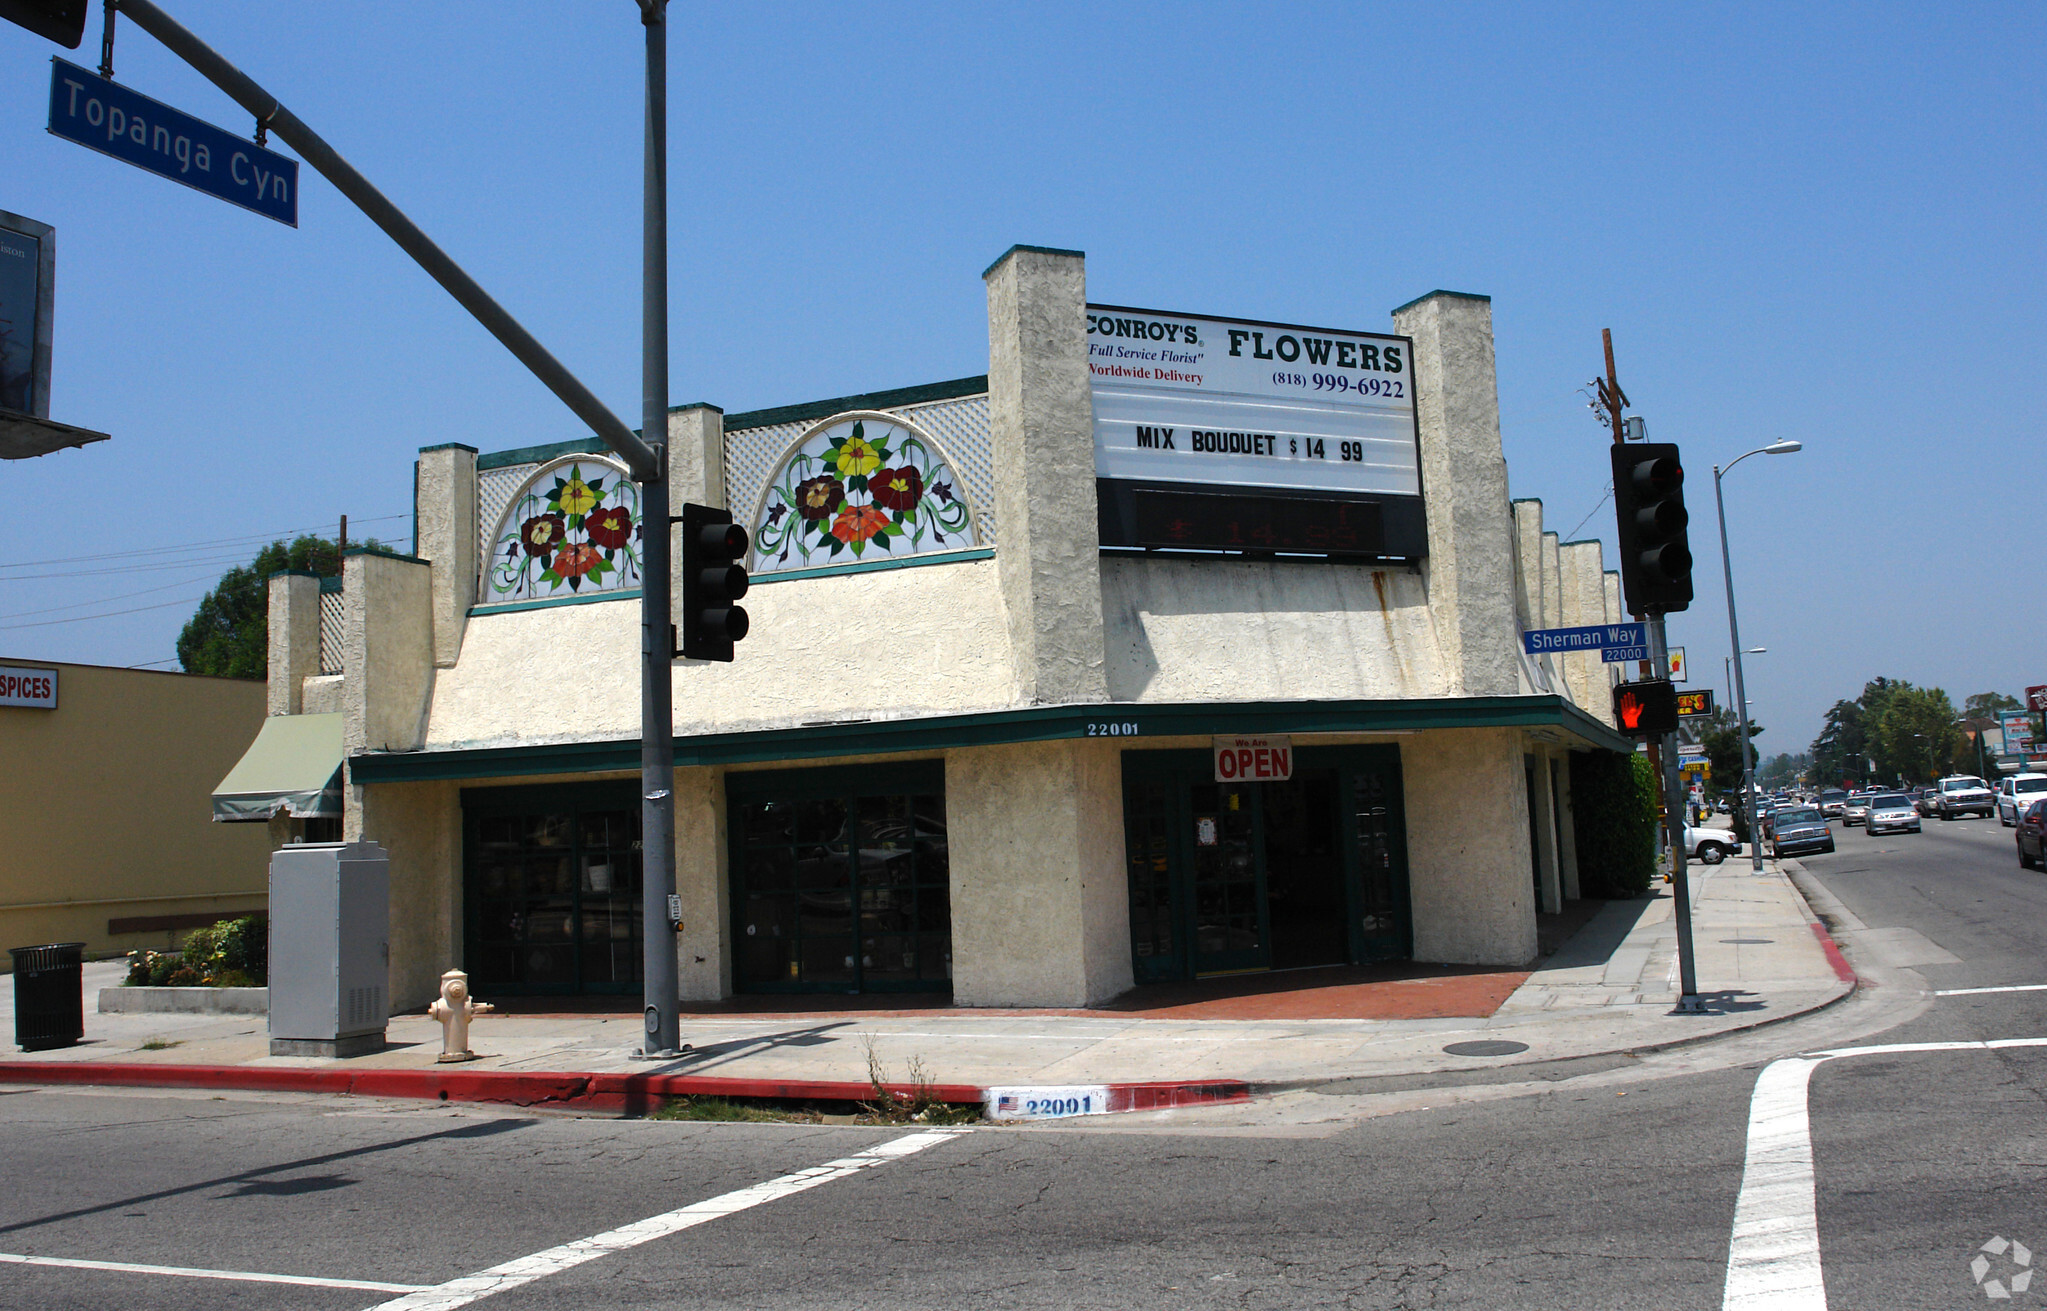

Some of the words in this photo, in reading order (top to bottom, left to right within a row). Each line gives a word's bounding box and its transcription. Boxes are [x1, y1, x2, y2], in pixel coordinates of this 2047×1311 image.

[64, 78, 210, 173] Topanga
[230, 152, 287, 203] Cyn
[1086, 314, 1198, 345] CONROY'S
[1228, 329, 1403, 374] FLOWERS
[1086, 343, 1114, 357] Full
[1116, 345, 1157, 361] Service
[1161, 349, 1204, 364] Florist"
[1154, 368, 1204, 386] Delivery
[1272, 371, 1307, 389] (818)
[1312, 372, 1404, 399] 999-6922
[1136, 426, 1175, 450] MIX
[1191, 430, 1276, 456] BOUQUET
[1306, 438, 1325, 459] 14
[1340, 440, 1363, 462] 99
[1532, 632, 1601, 649] Sherman
[1607, 627, 1638, 646] Way
[1606, 648, 1642, 661] 22000
[0, 675, 51, 699] SPICES
[1677, 707, 1693, 715] ER
[1088, 722, 1138, 736] 22001
[1235, 738, 1250, 747] We
[1252, 738, 1268, 747] Are
[1219, 748, 1289, 779] OPEN
[1026, 1095, 1091, 1116] 22001
